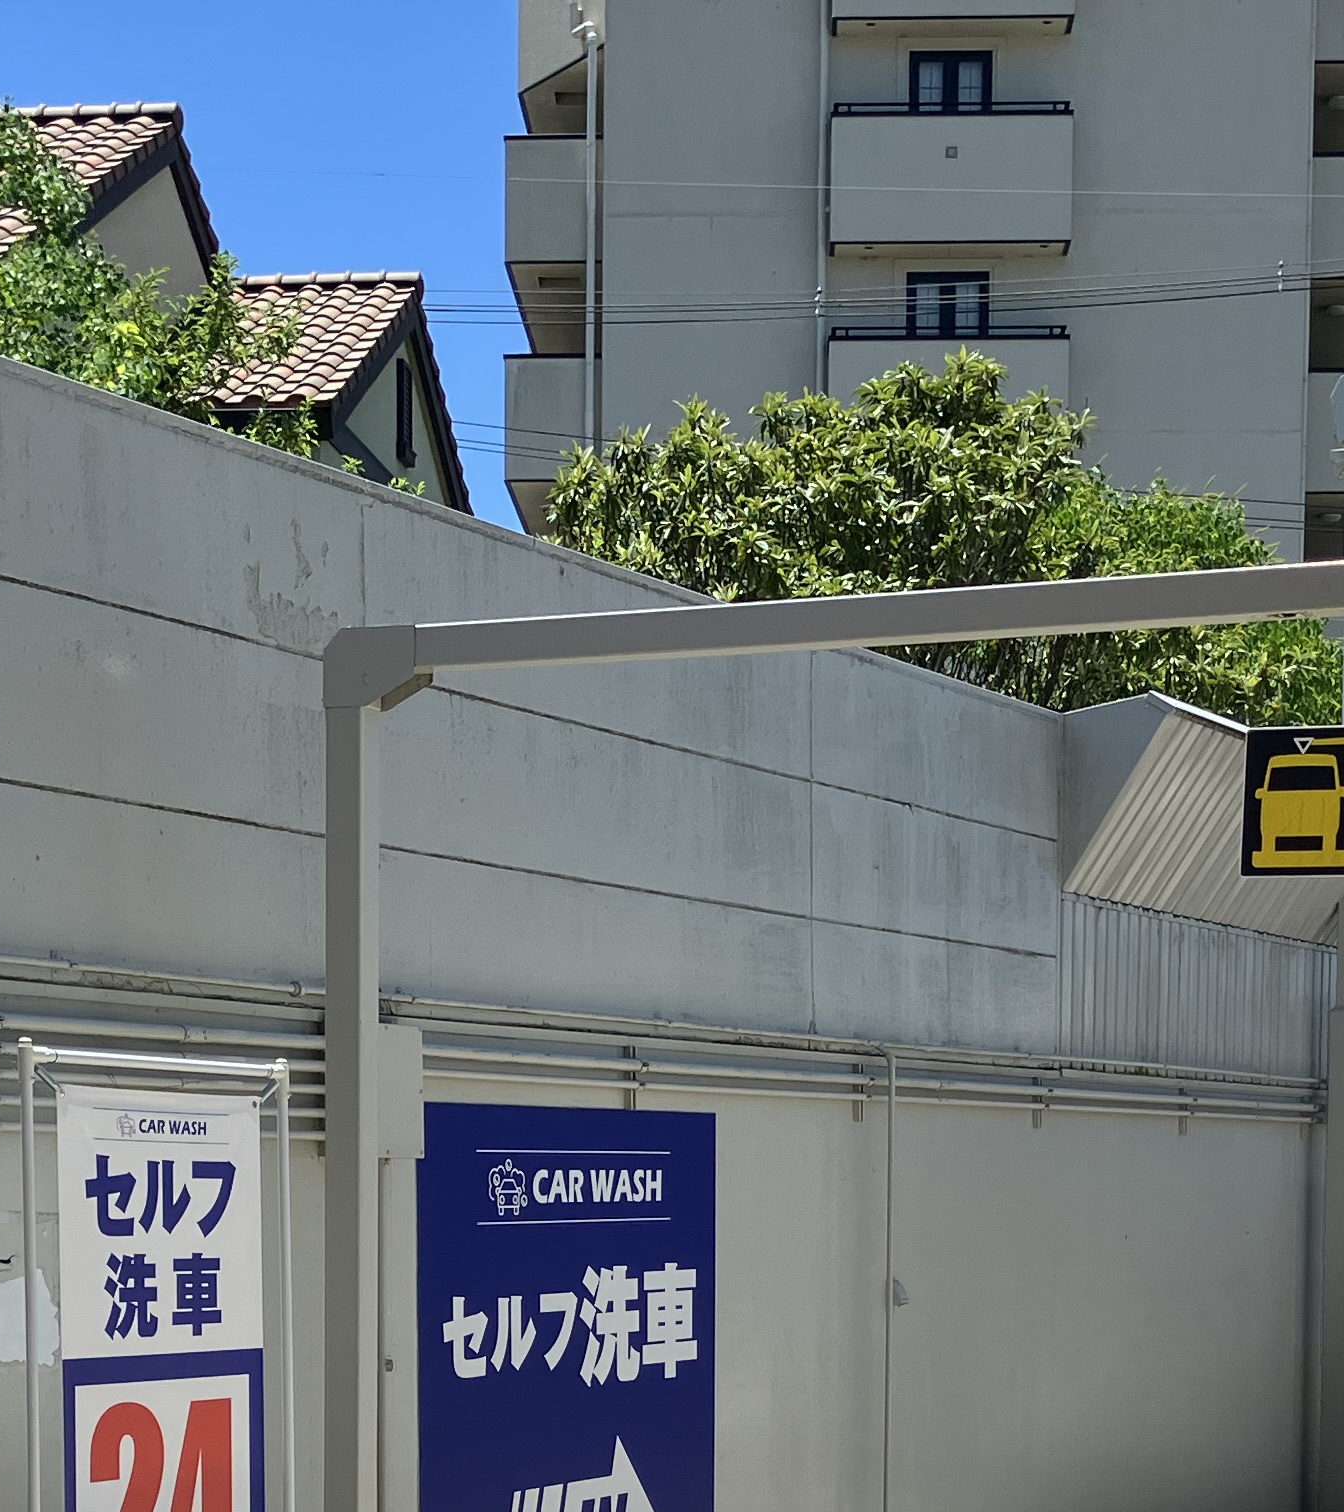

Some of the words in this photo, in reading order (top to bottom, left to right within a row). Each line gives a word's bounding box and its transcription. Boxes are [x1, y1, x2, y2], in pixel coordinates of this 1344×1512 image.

[138, 1119, 165, 1134] CAR
[169, 1120, 207, 1135] WASH
[85, 1154, 236, 1238] セルフ
[532, 1168, 585, 1204] CAR
[590, 1169, 663, 1203] WASH
[104, 1252, 222, 1340] 洗車
[442, 1262, 698, 1388] セルフ洗車
